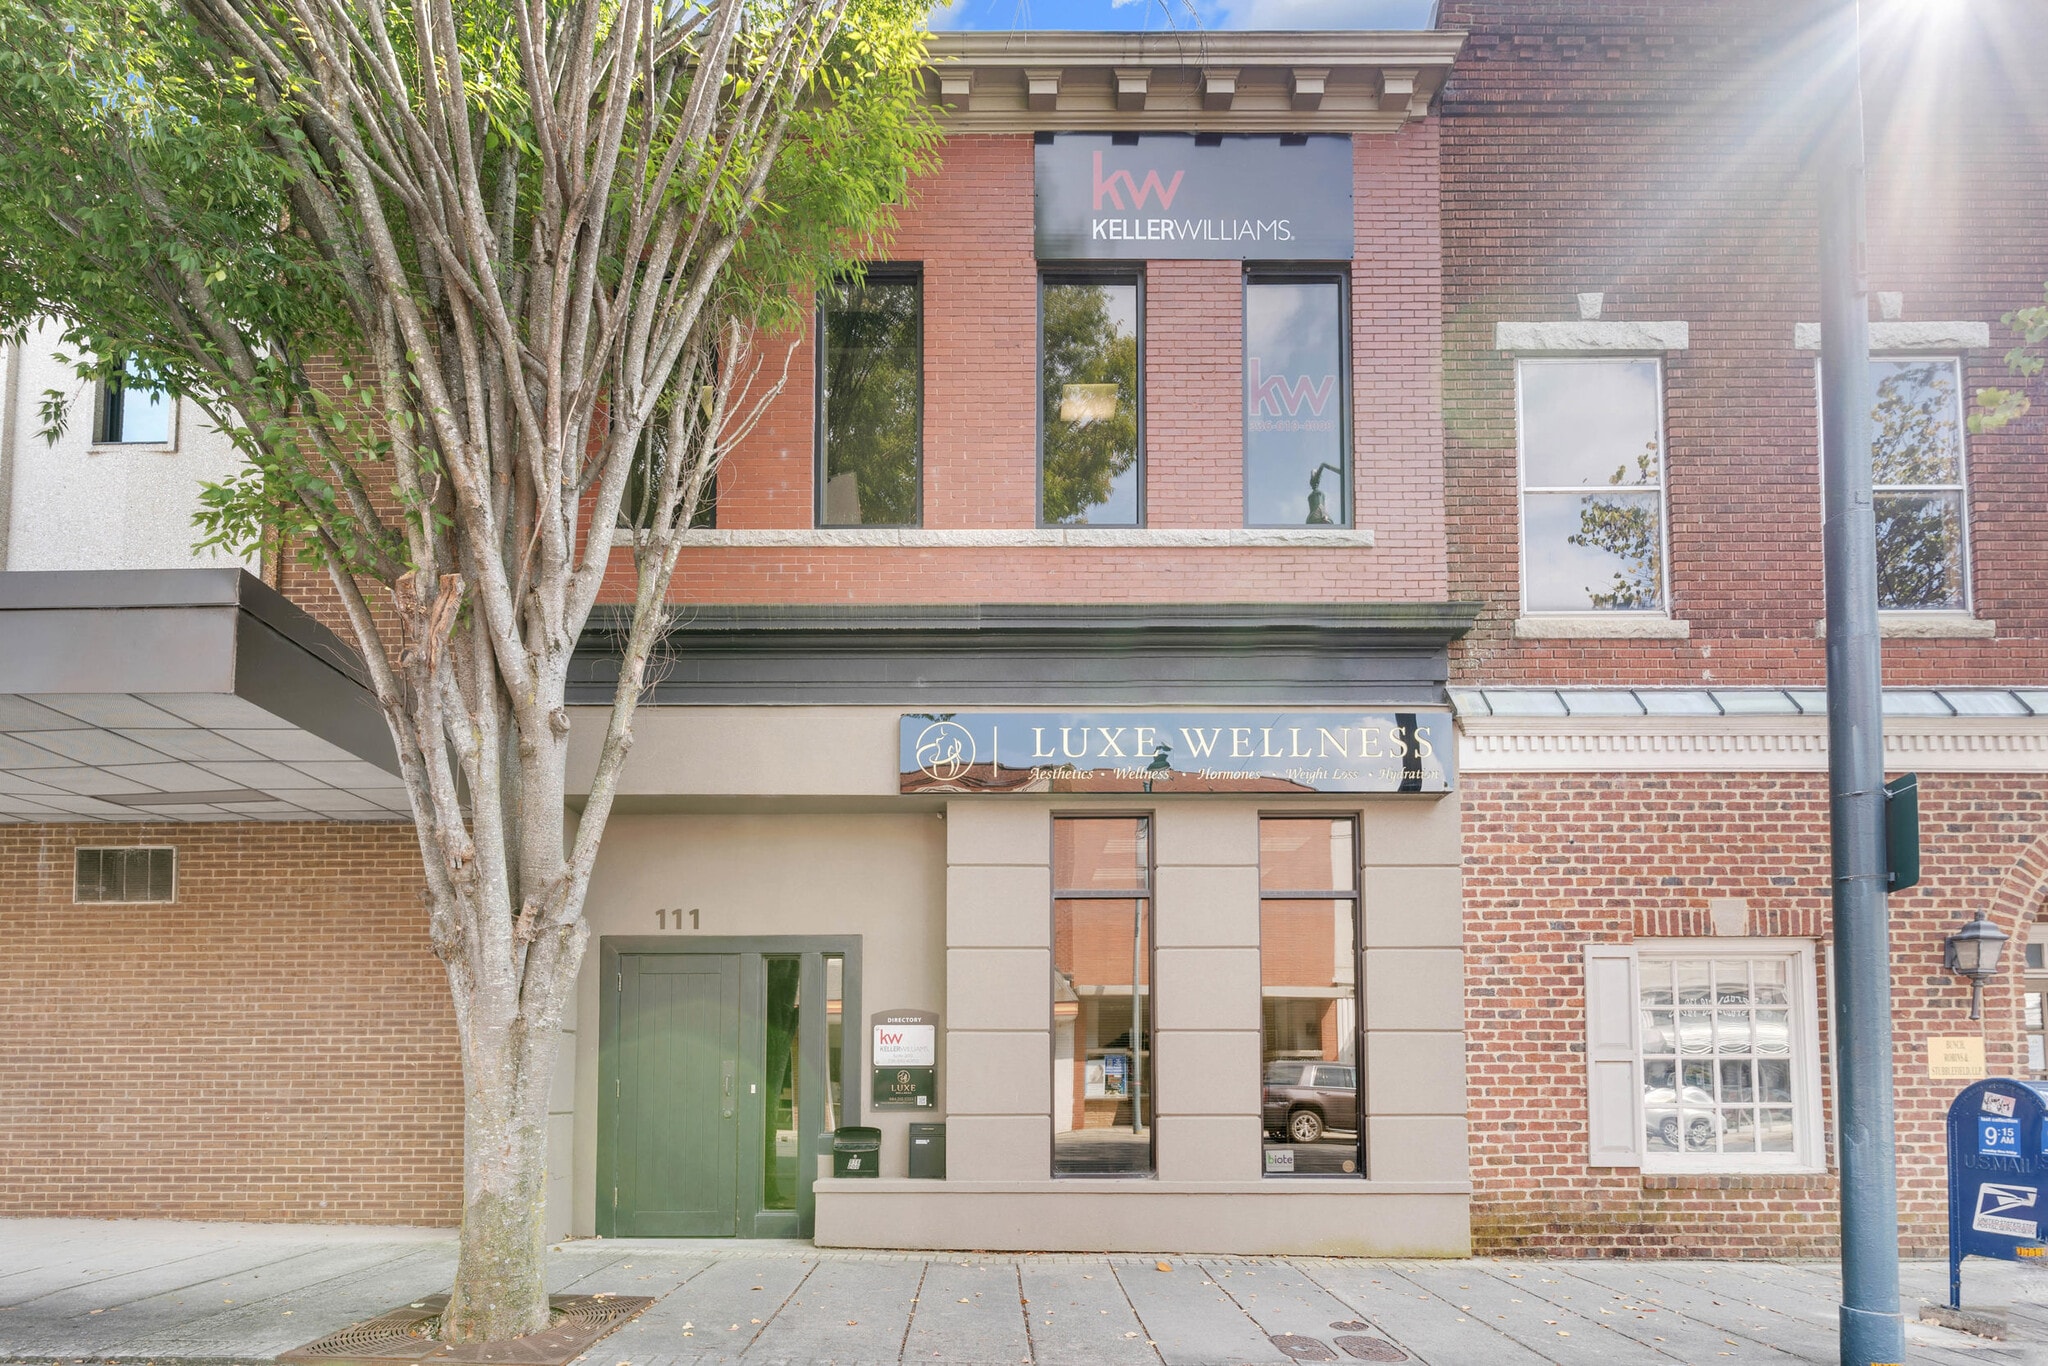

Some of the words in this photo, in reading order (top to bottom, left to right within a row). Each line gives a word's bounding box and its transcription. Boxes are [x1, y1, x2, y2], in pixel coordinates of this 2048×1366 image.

[1093, 151, 1185, 210] kw
[1249, 357, 1336, 416] kw
[1031, 727, 1159, 758] LUXE
[1179, 727, 1433, 758] WELLNESS
[1028, 766, 1094, 780] Aesthetics
[1112, 765, 1170, 780] Wellness
[1197, 767, 1261, 780] Hormones
[1285, 767, 1328, 786] Weight
[1332, 768, 1359, 780] Loss
[655, 908, 700, 930] 111
[880, 1029, 903, 1045] kw
[891, 1084, 917, 1092] LUXE
[2000, 1137, 2015, 1145] AM
[1267, 1151, 1293, 1164] biote
